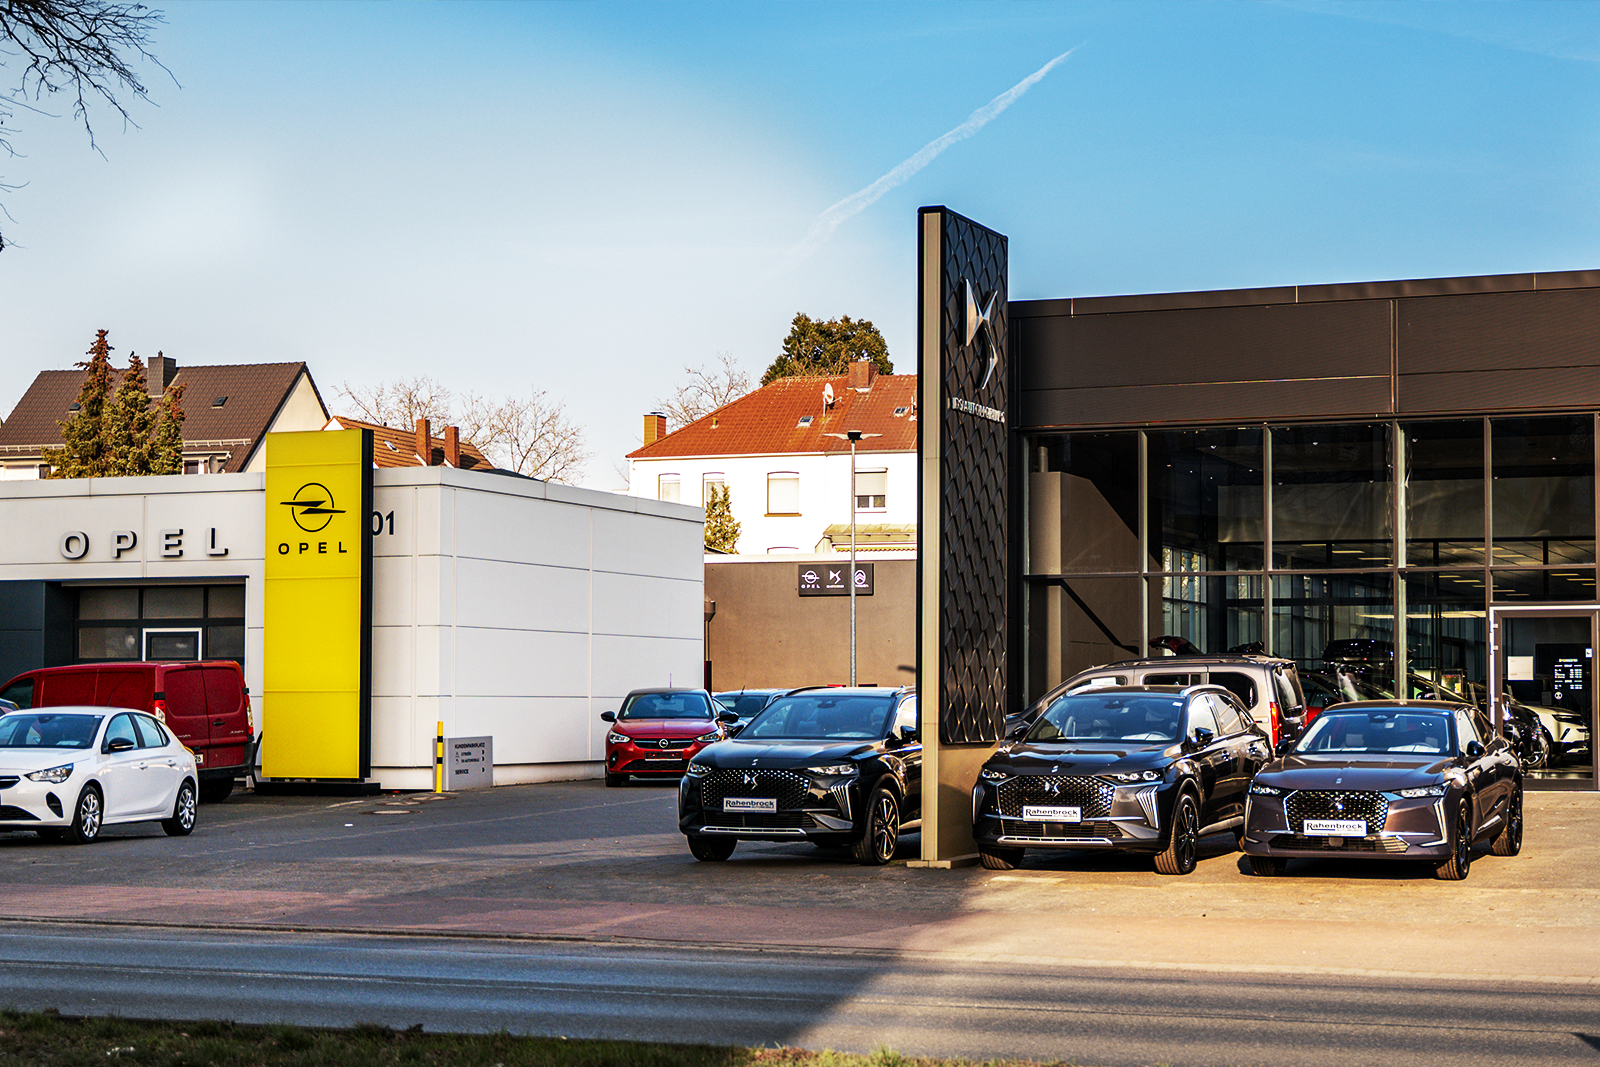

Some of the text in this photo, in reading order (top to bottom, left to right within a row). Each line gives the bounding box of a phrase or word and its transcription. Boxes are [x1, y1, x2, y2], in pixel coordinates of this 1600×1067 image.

[372, 510, 394, 536] 01
[60, 527, 229, 560] OPEL
[278, 541, 348, 555] OPEL
[725, 800, 775, 808] Rahenbrock
